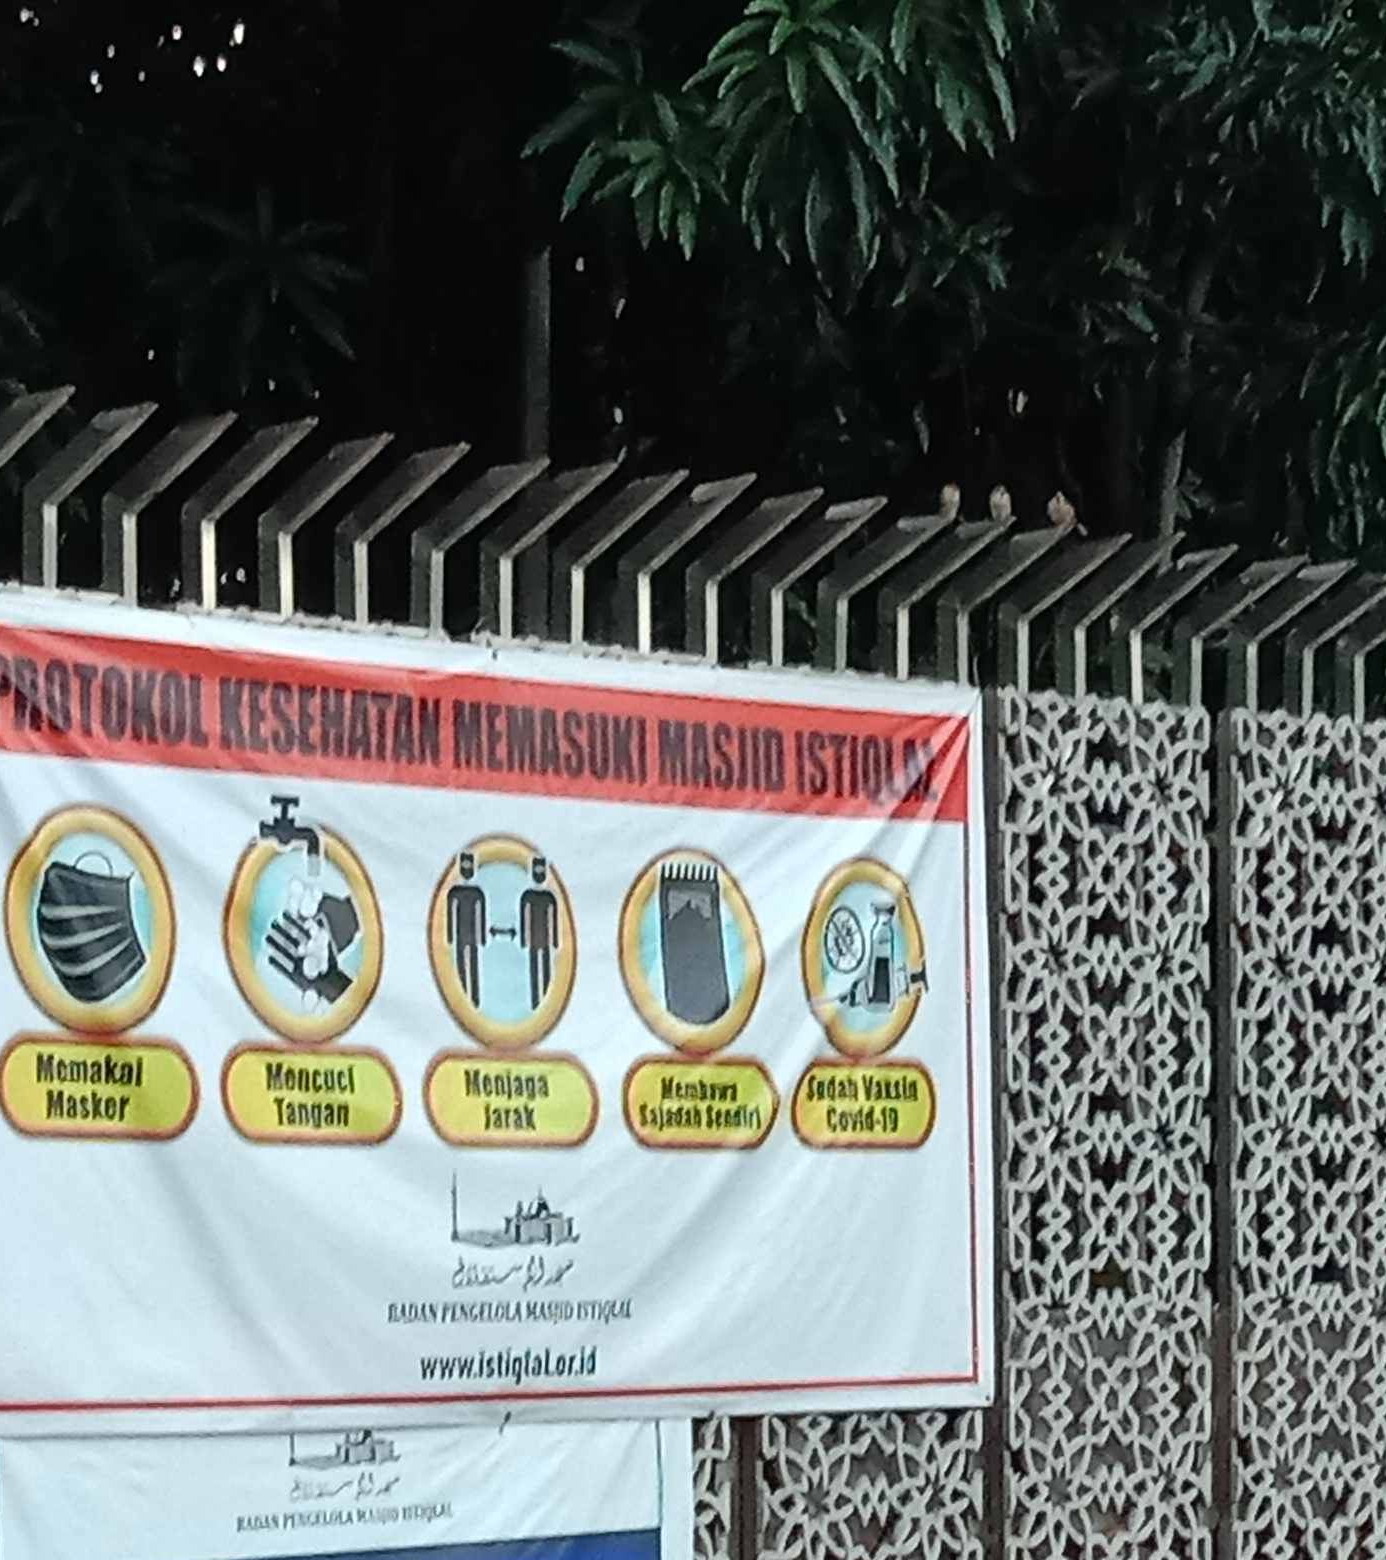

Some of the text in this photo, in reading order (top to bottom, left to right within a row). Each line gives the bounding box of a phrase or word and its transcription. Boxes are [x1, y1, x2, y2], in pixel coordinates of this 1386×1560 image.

[220, 675, 441, 767] KESEHATAN
[453, 699, 648, 786] MEMASUKI
[659, 718, 785, 793] MASJID
[795, 730, 939, 804] ISTIQLAL
[36, 1053, 143, 1087] Memakai
[266, 1062, 355, 1095] Mencuci
[464, 1068, 550, 1101] Menjaga
[806, 1075, 918, 1101] Sudah Vaksin
[46, 1089, 130, 1121] Masker
[273, 1097, 350, 1128] Tangan
[485, 1102, 536, 1131] Jarak
[639, 1105, 762, 1131] Sajadah Sendiri
[827, 1105, 899, 1133] Covid-19
[388, 1298, 632, 1324] BADAN PENGELOLA MASJID ISTIQLAL
[421, 1345, 597, 1386] www.istiqlal.or.id
